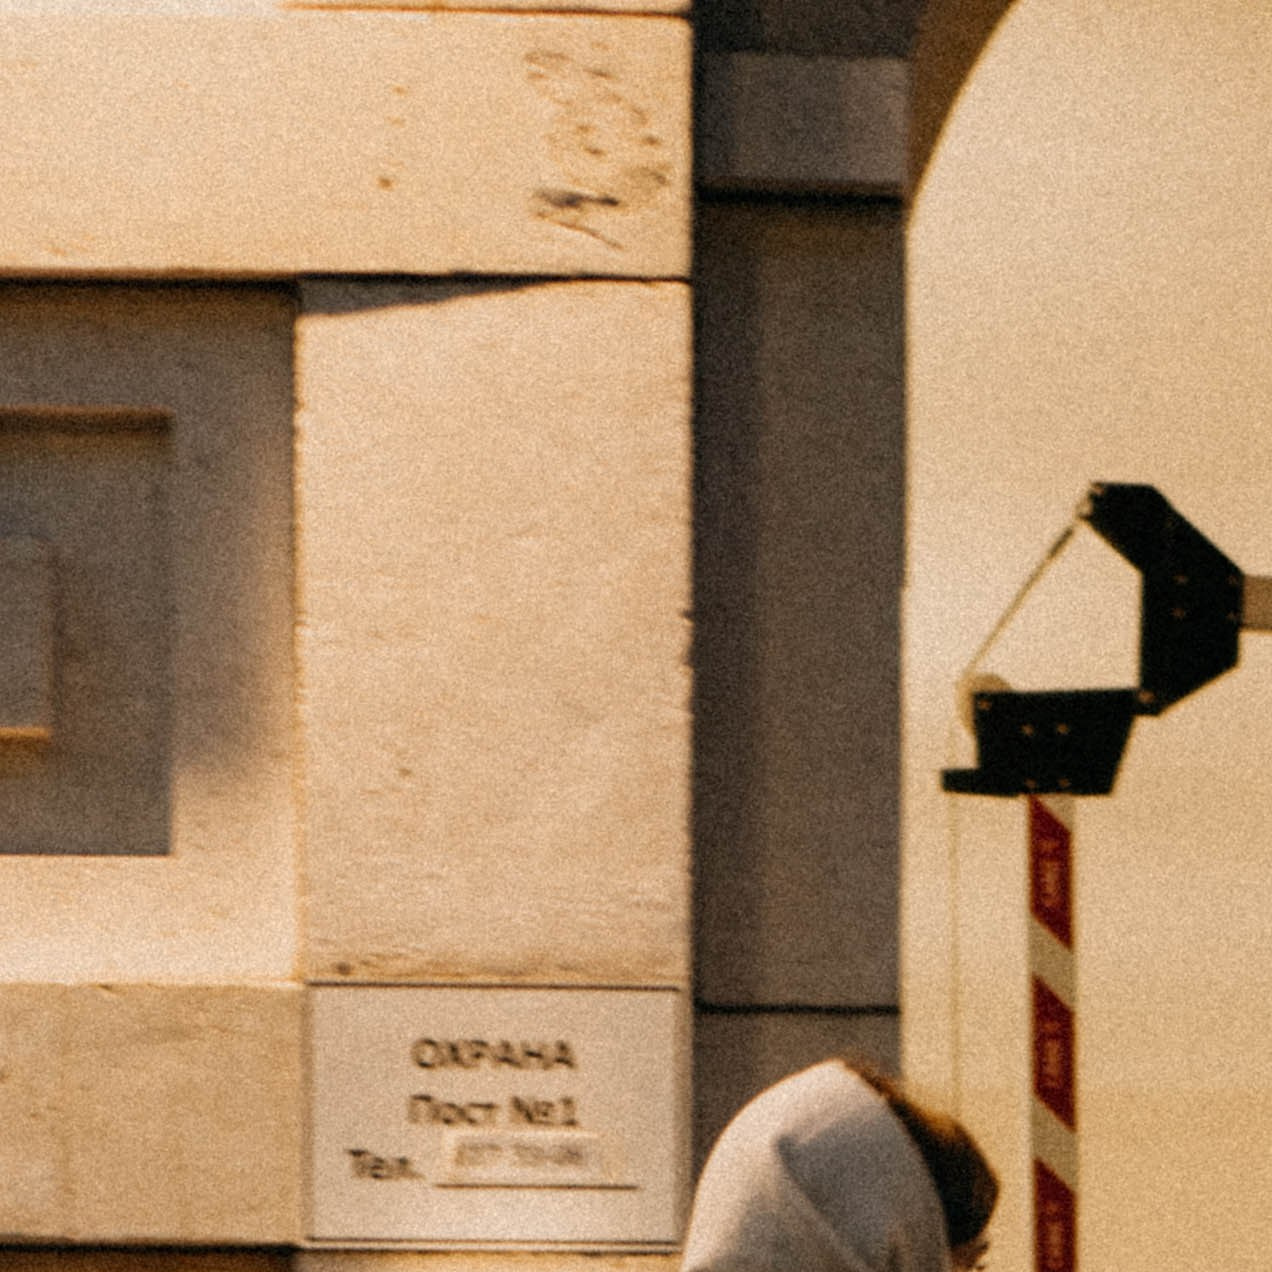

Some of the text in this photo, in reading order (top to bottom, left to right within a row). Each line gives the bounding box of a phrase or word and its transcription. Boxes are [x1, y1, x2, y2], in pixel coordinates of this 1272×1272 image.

[410, 1037, 577, 1069] ОХРАНА
[408, 1093, 578, 1127] Пост №1
